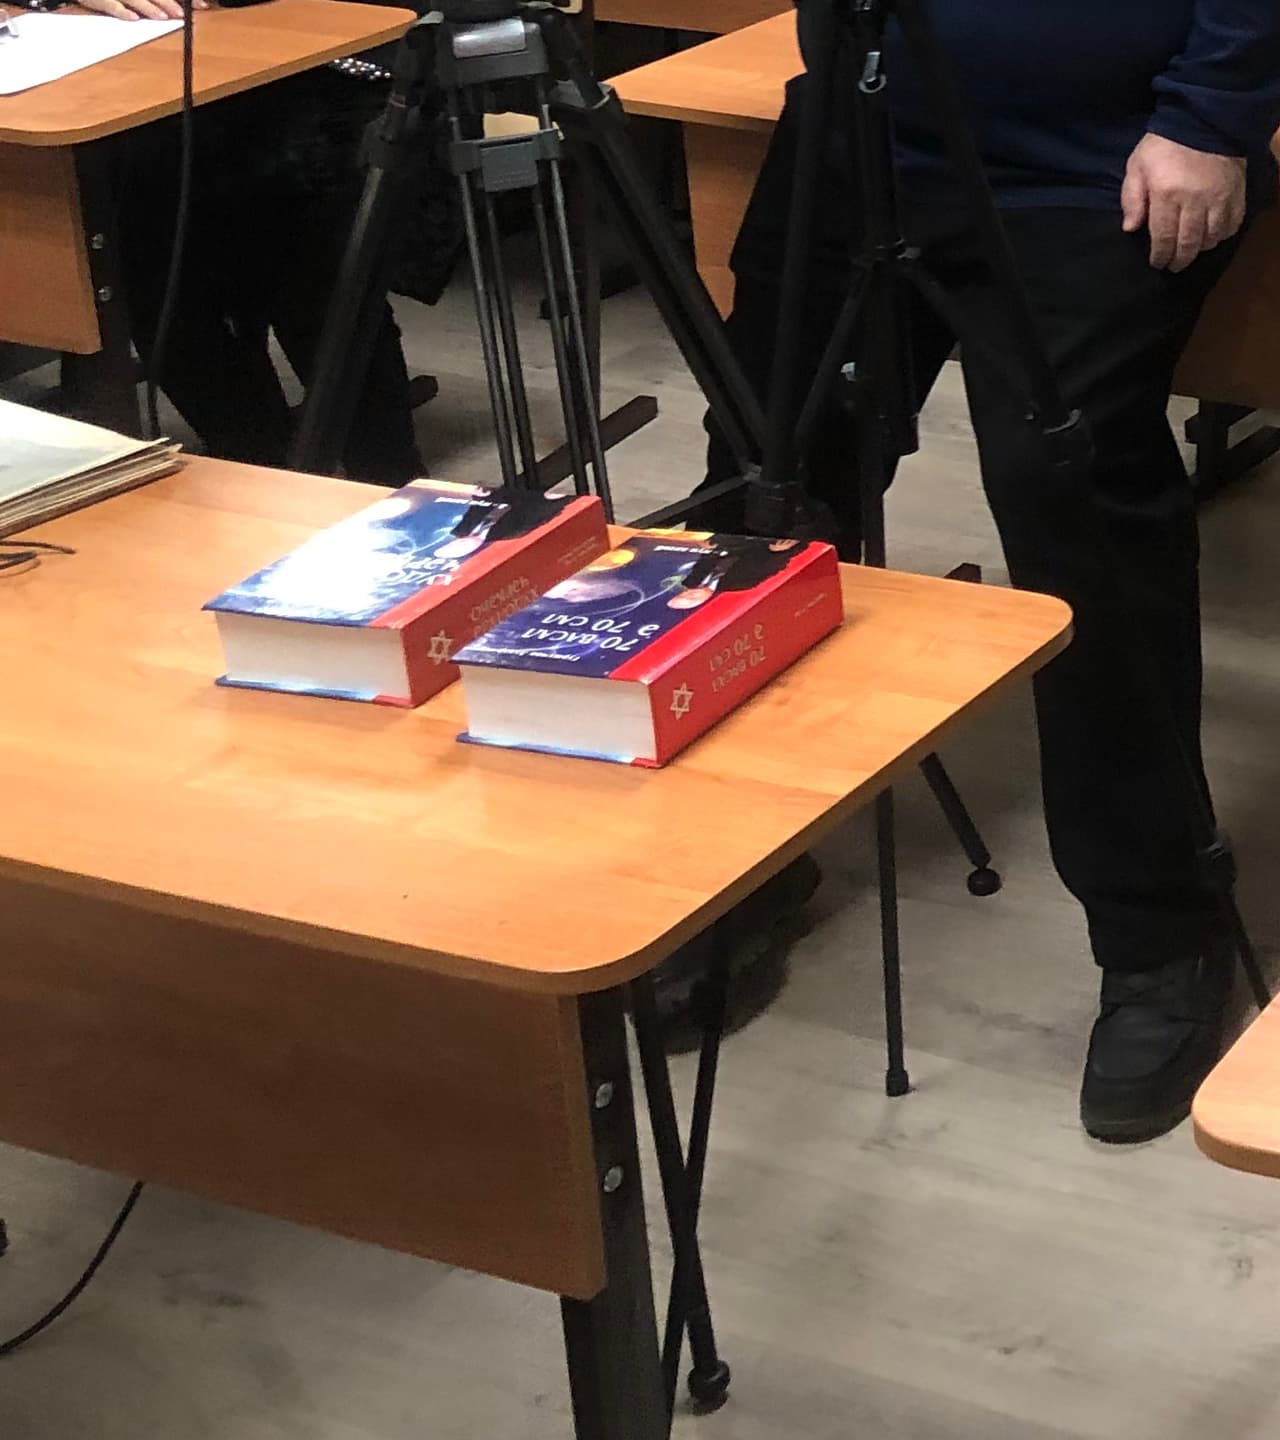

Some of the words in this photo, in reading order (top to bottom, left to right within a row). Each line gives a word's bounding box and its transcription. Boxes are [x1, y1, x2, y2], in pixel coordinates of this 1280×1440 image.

[541, 613, 589, 626] САЛ
[592, 619, 632, 634] 70
[521, 628, 600, 645] ВАСАЛ
[600, 636, 639, 652] 70
